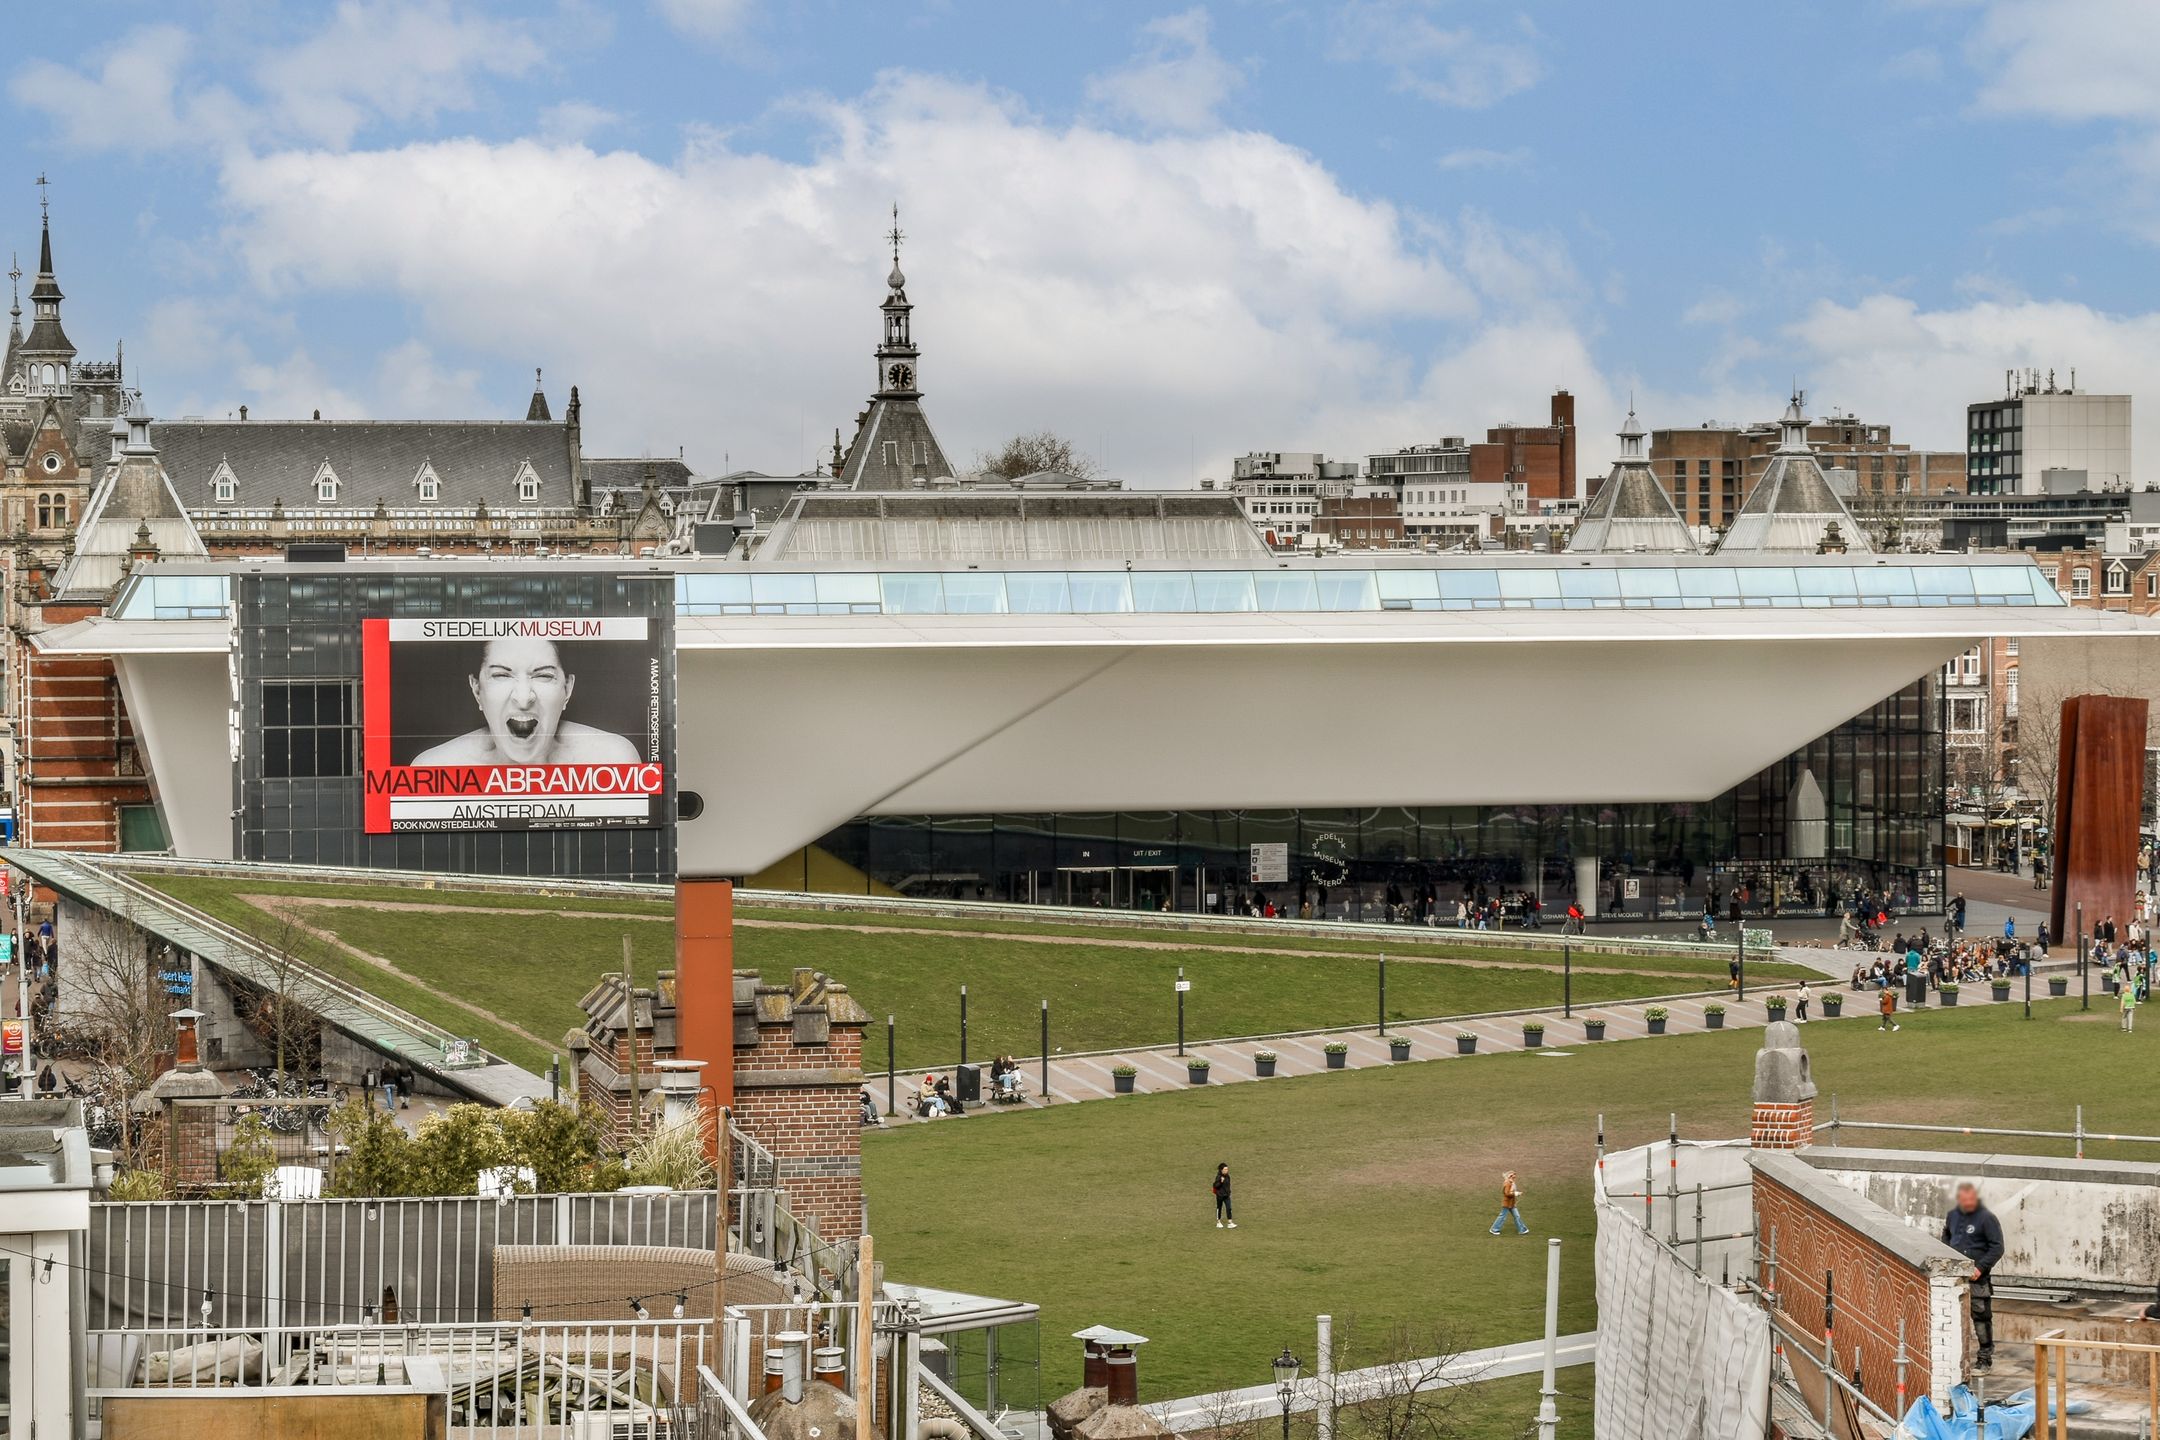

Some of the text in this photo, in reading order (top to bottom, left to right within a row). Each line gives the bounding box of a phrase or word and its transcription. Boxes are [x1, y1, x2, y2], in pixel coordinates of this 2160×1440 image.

[651, 666, 659, 694] MAJOR
[651, 696, 660, 762] RETROSPECTIVE
[366, 763, 660, 794] MARINA ABRAMOVIĆ
[453, 803, 575, 819] AMSTERDAM
[393, 820, 498, 830] BOOK NOW STEDELIJK.NL
[1314, 851, 1345, 866] MUSEUM
[1311, 868, 1348, 887] AMSTERDAM
